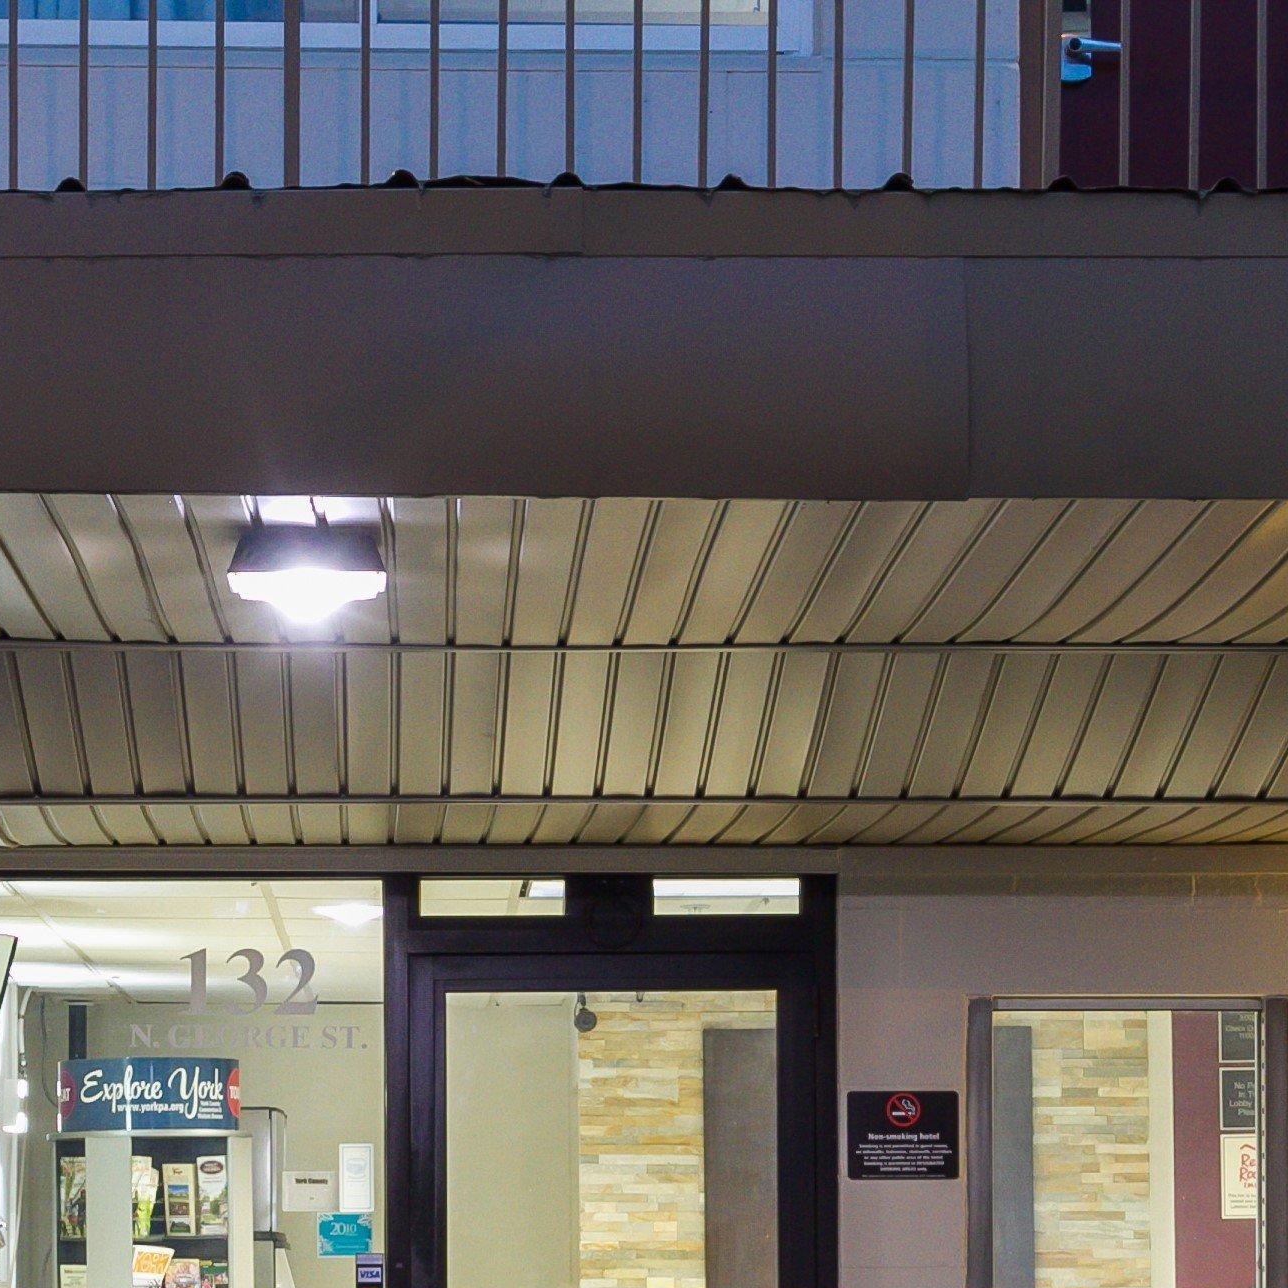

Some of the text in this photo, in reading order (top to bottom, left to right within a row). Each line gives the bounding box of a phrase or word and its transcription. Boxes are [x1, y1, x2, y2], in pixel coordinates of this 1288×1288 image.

[180, 949, 318, 1015] 132
[129, 1023, 367, 1049] N. GEORGE ST.
[80, 1065, 223, 1119] Explore York
[117, 1103, 184, 1113] www.yorkpa.org
[868, 1132, 940, 1142] Non-smoking hotel
[360, 1270, 380, 1279] VISA
